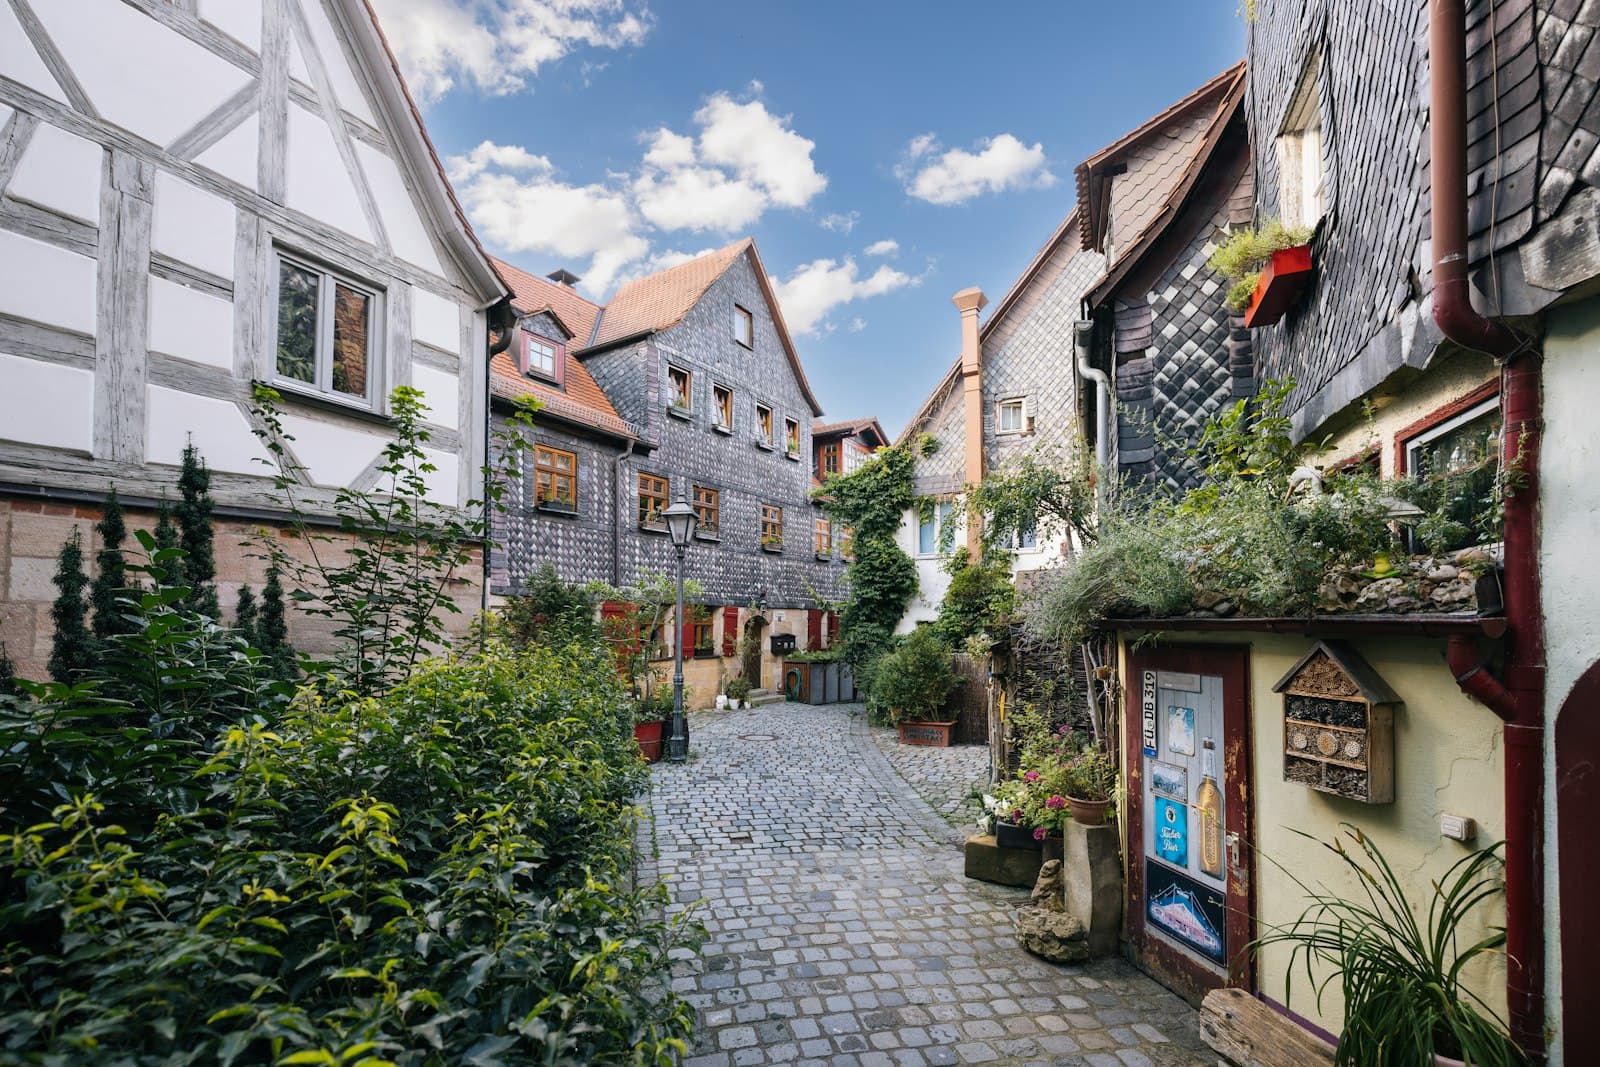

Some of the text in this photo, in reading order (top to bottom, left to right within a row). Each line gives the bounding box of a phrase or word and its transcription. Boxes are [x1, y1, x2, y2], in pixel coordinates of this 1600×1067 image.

[1144, 672, 1155, 749] FÜ DB 319
[1160, 826, 1182, 839] Tucher
